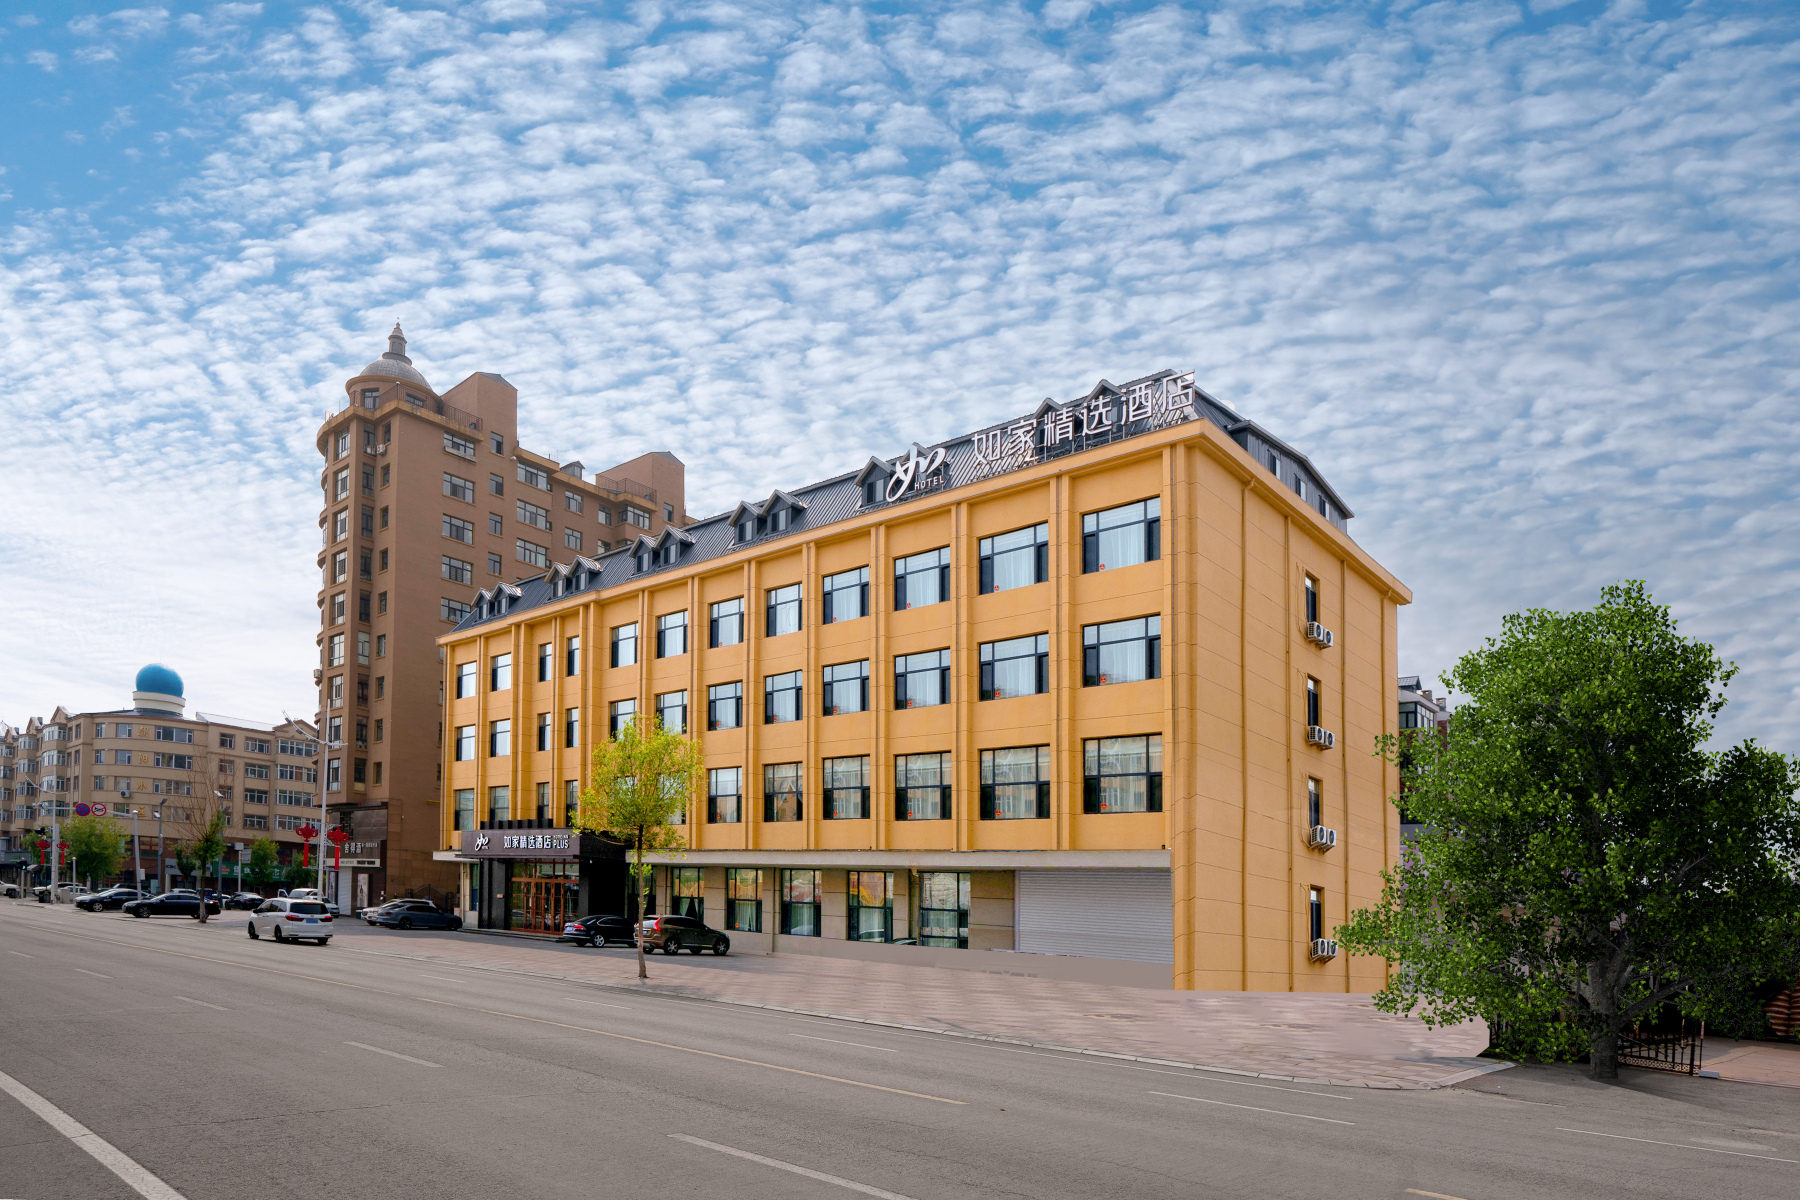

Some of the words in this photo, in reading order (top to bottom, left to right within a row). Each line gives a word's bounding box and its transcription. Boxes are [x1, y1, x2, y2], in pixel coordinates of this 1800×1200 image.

[971, 368, 1196, 465] 如家精选酒店
[914, 475, 944, 491] HOTEL
[503, 834, 552, 849] 如家精选酒店
[553, 839, 569, 849] PLUS
